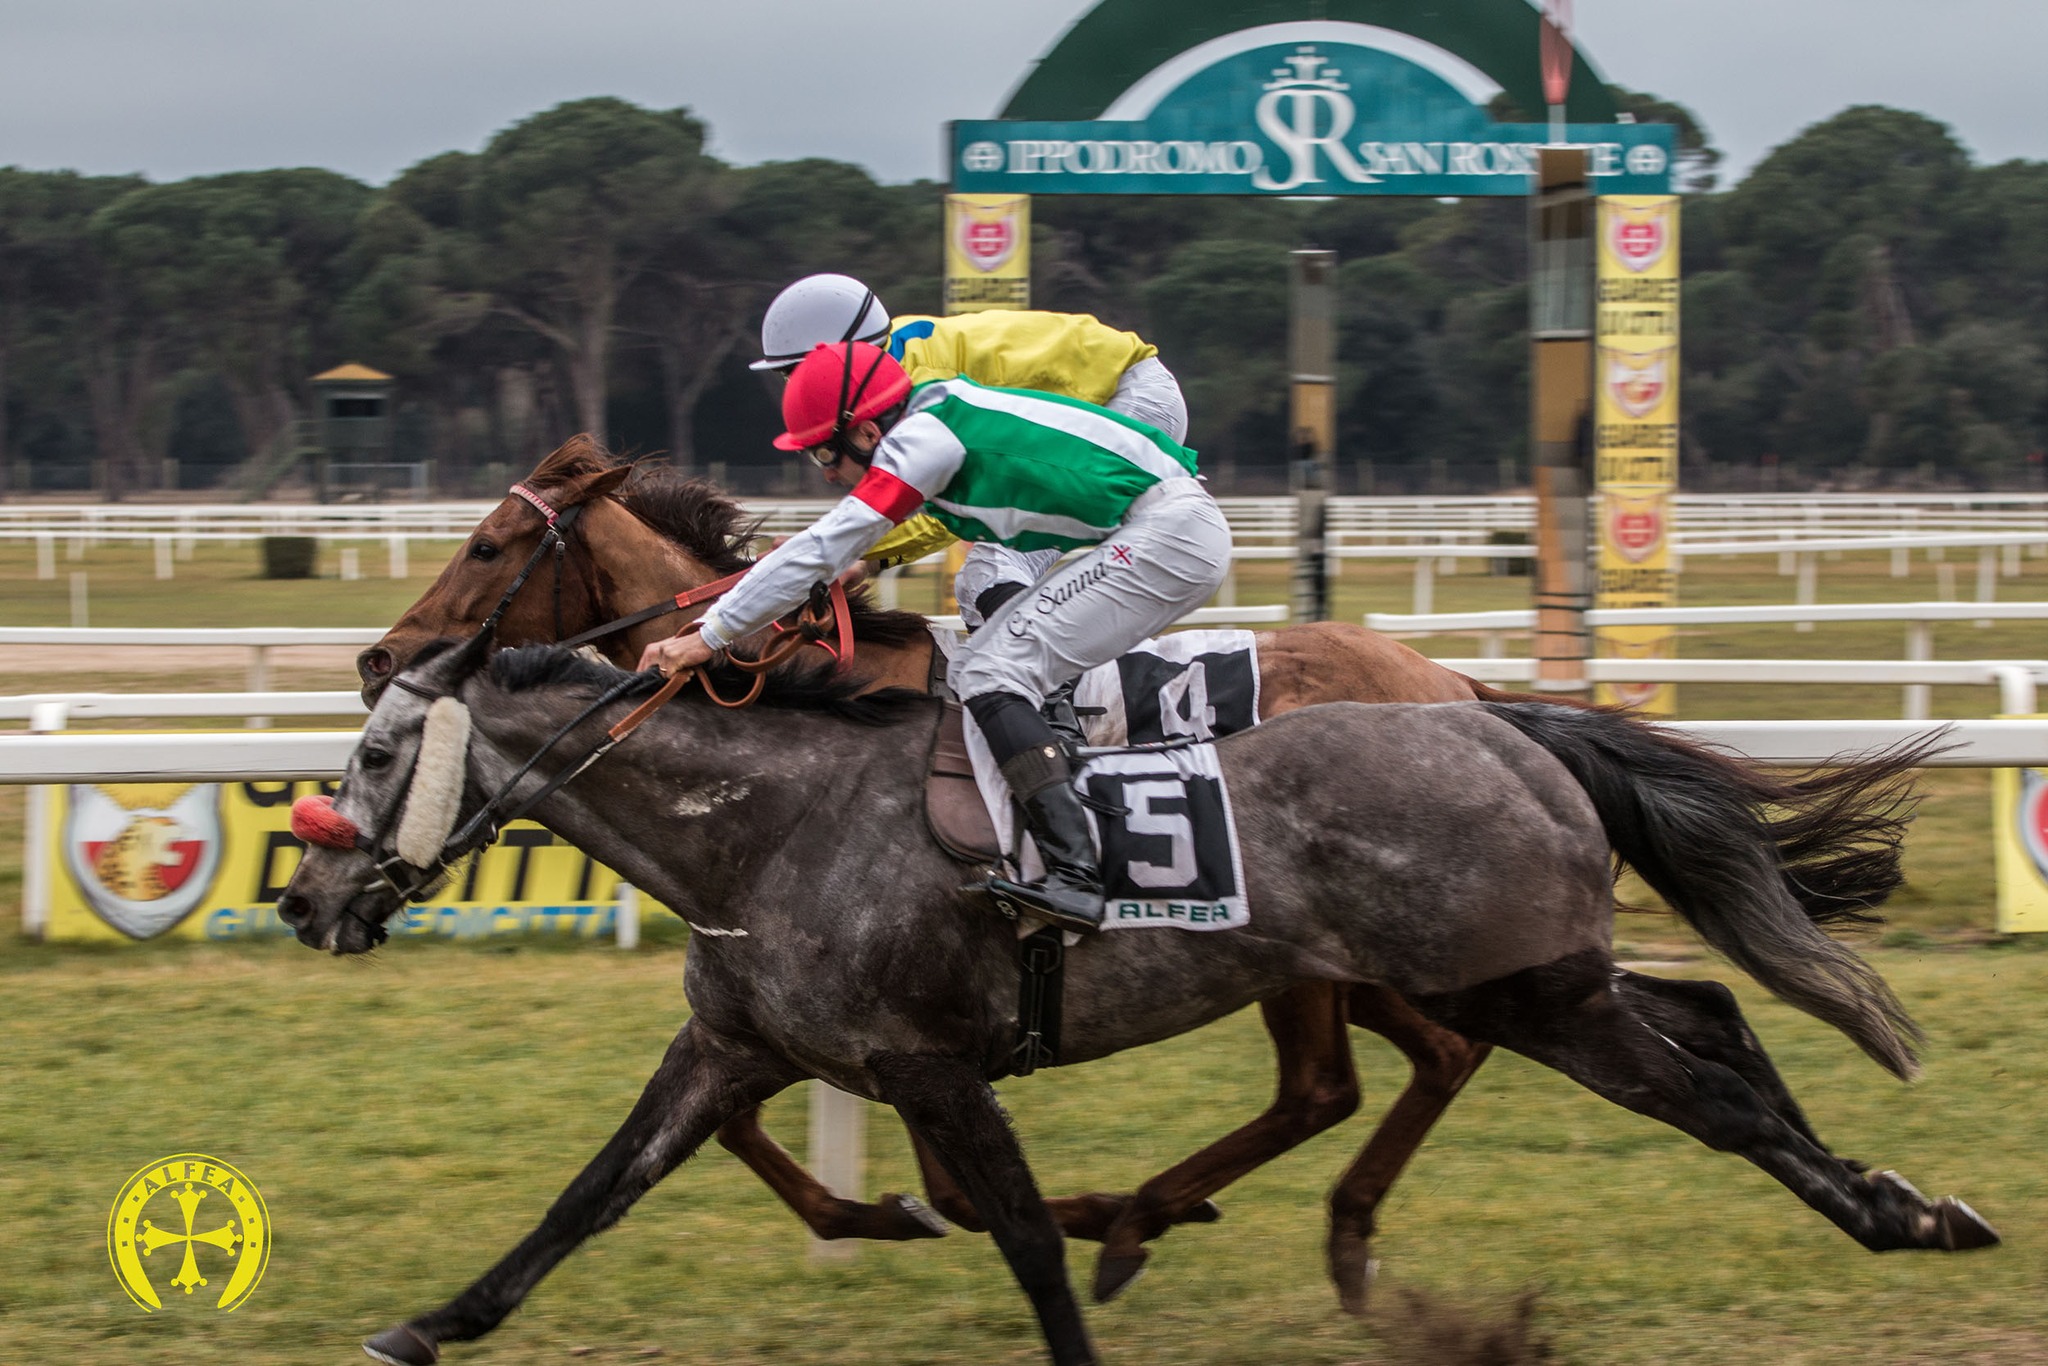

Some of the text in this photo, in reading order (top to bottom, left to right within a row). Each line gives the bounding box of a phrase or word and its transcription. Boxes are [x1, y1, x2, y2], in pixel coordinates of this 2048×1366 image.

[1004, 140, 1625, 176] IPPODROMO SAN ROSSE
[1036, 562, 1107, 615] Sanna
[1158, 661, 1217, 742] 4
[1122, 778, 1198, 888] 5
[1118, 903, 1230, 923] ALFEA
